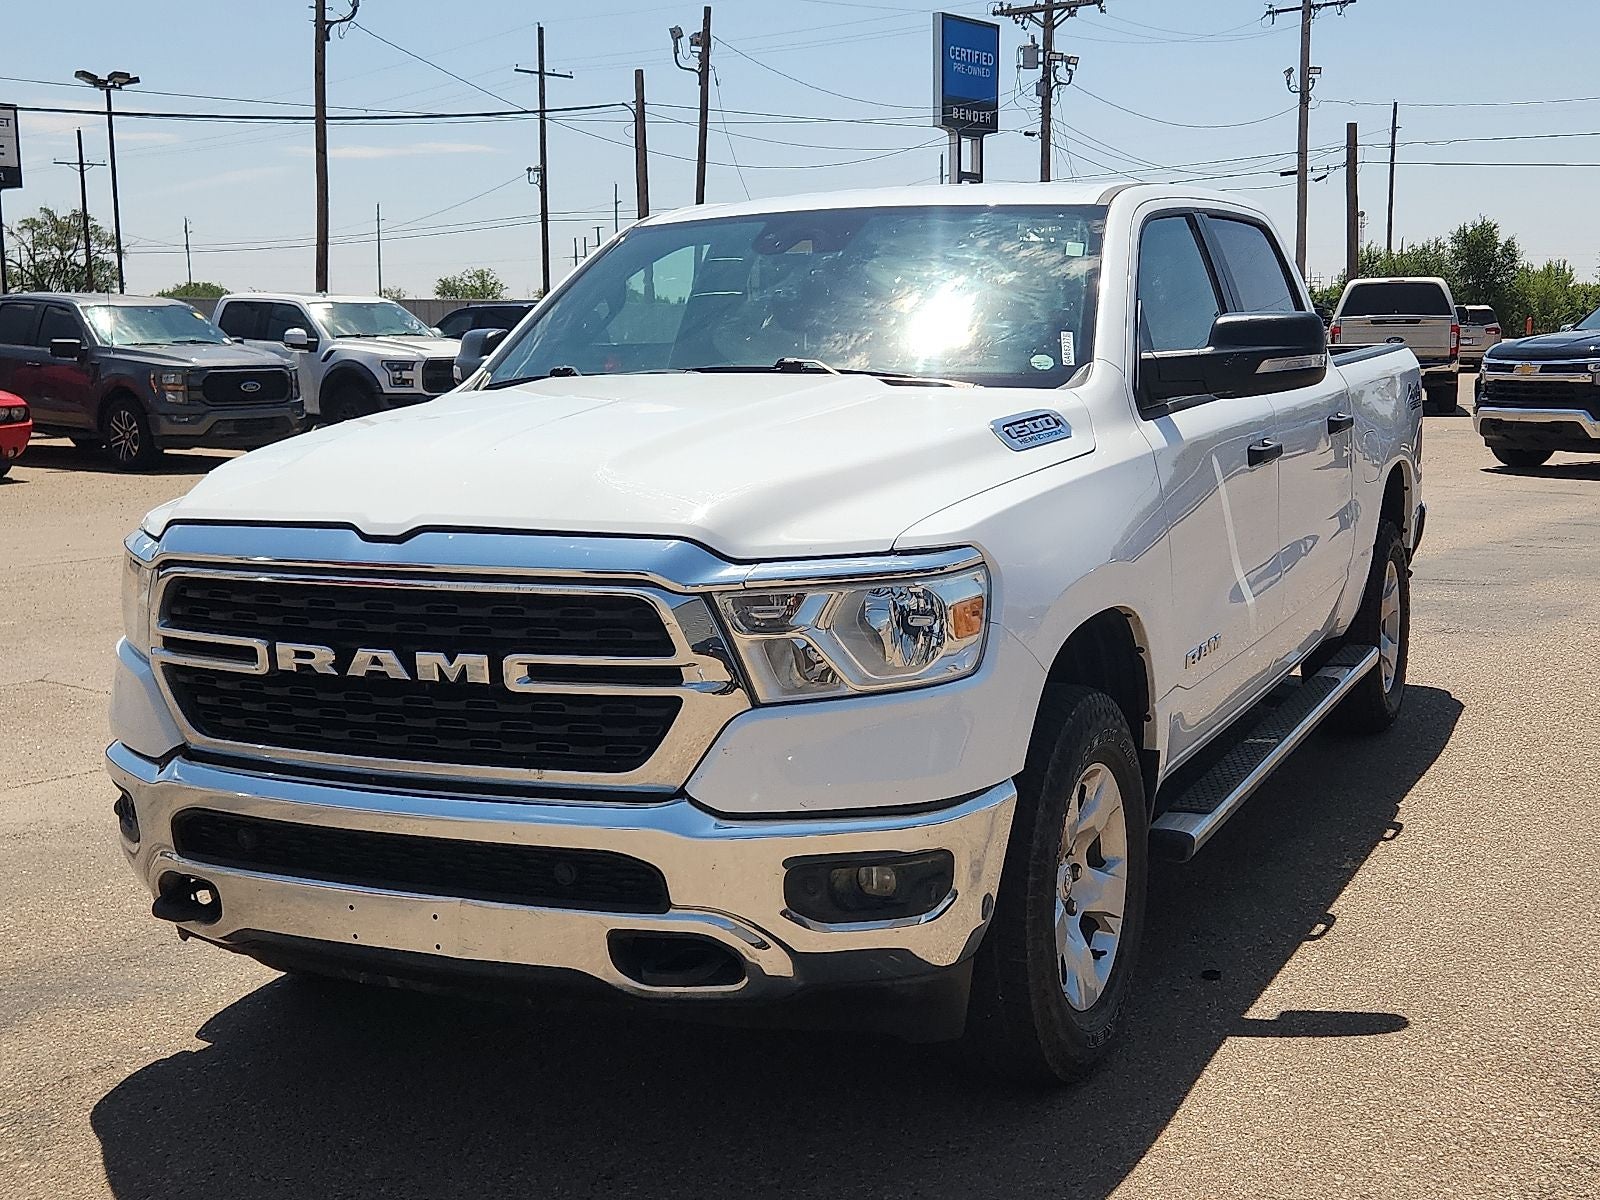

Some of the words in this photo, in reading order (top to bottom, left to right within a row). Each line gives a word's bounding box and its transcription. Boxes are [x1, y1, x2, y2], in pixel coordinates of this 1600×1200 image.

[949, 45, 994, 66] CERTIFIED
[953, 62, 991, 78] PRE-OWNED
[952, 106, 991, 124] BENDER
[1004, 416, 1056, 438] 1500
[1184, 632, 1221, 669] RAM
[275, 641, 490, 684] RAM
